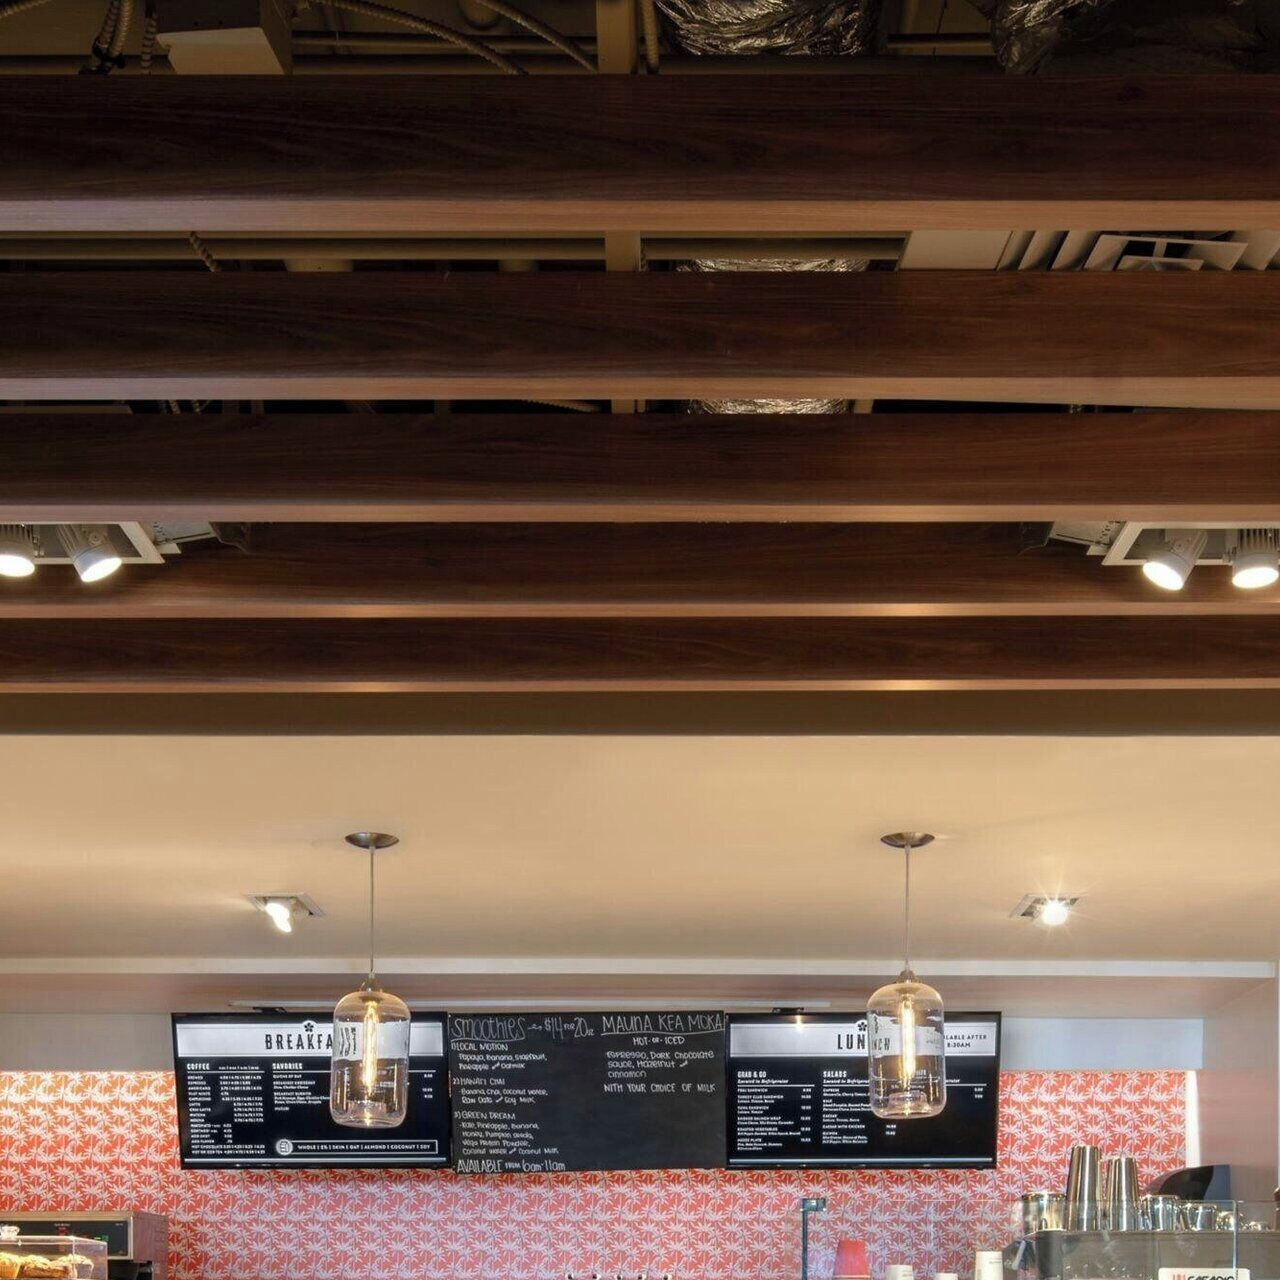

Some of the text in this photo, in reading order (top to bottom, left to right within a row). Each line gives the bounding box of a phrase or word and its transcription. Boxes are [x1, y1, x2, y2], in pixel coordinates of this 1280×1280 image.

[602, 1013, 722, 1033] MAUNA KEA MOKA
[265, 1033, 332, 1050] BREAKFA
[837, 1034, 867, 1050] LUN
[457, 1160, 503, 1173] AVAILABLE
